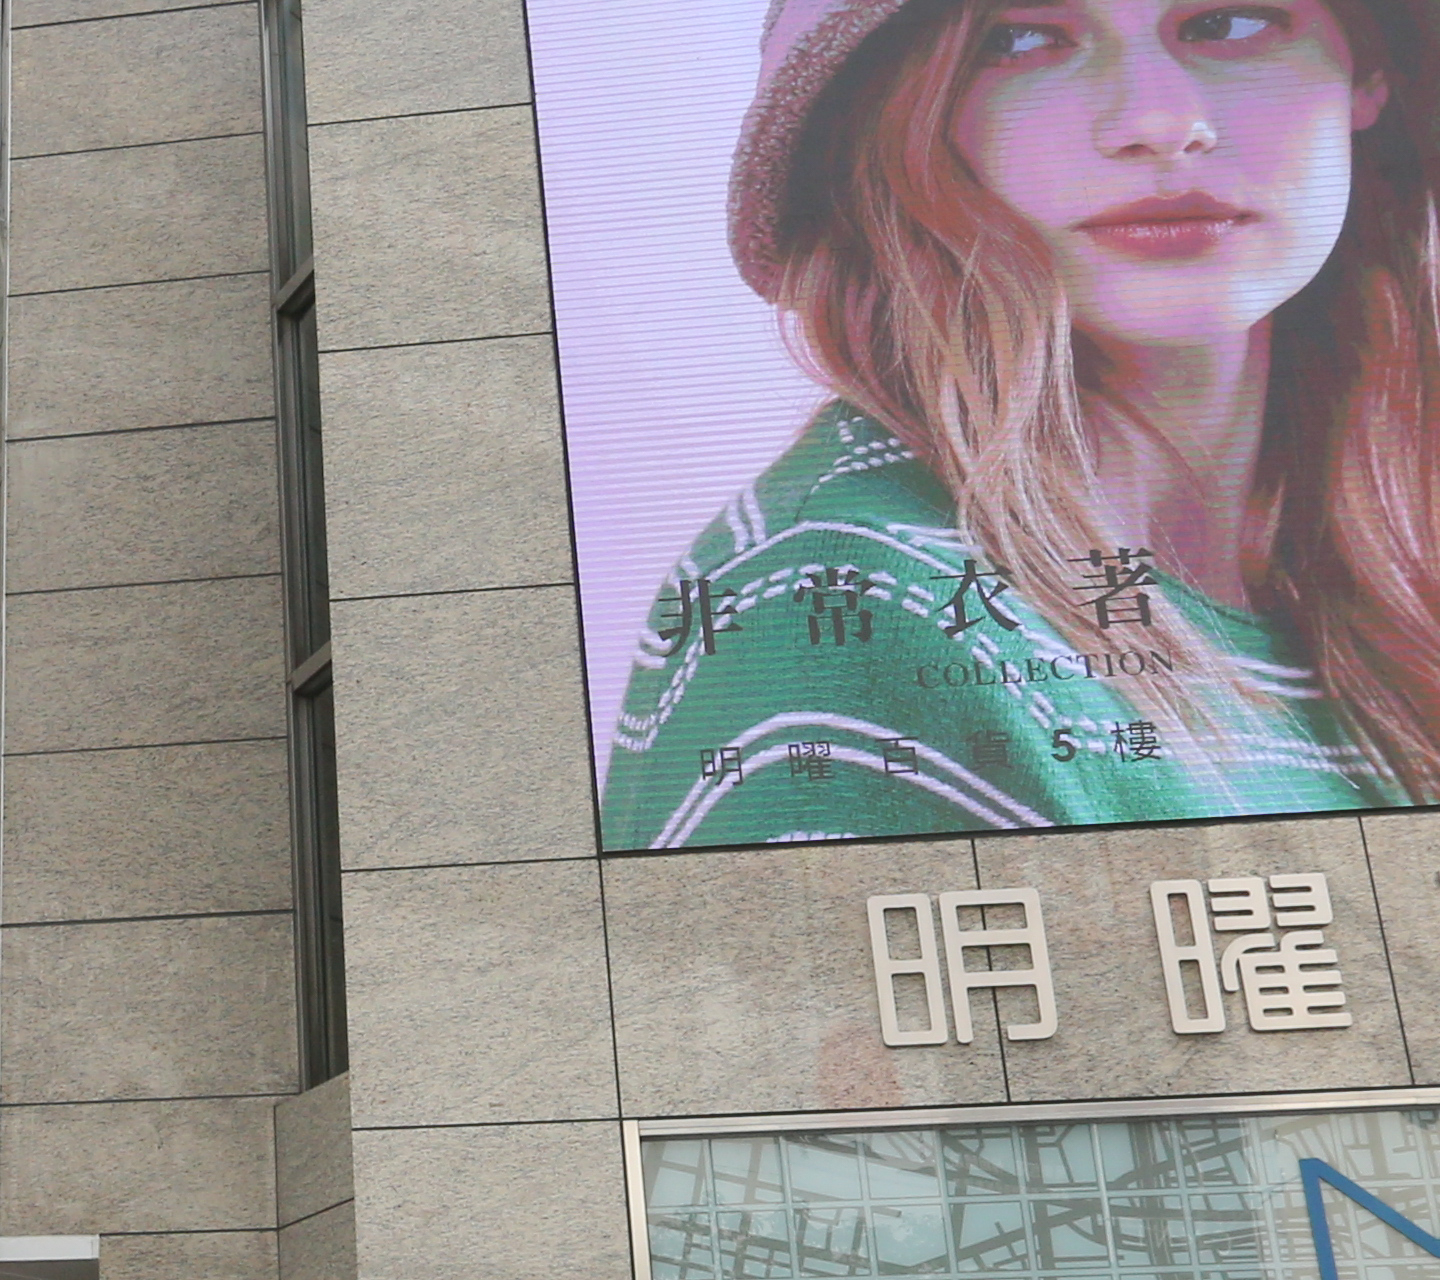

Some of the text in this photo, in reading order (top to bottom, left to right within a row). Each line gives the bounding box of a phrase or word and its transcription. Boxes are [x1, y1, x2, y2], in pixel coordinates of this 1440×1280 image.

[657, 546, 1160, 658] 非常衣著
[917, 648, 1175, 690] COLLECTION
